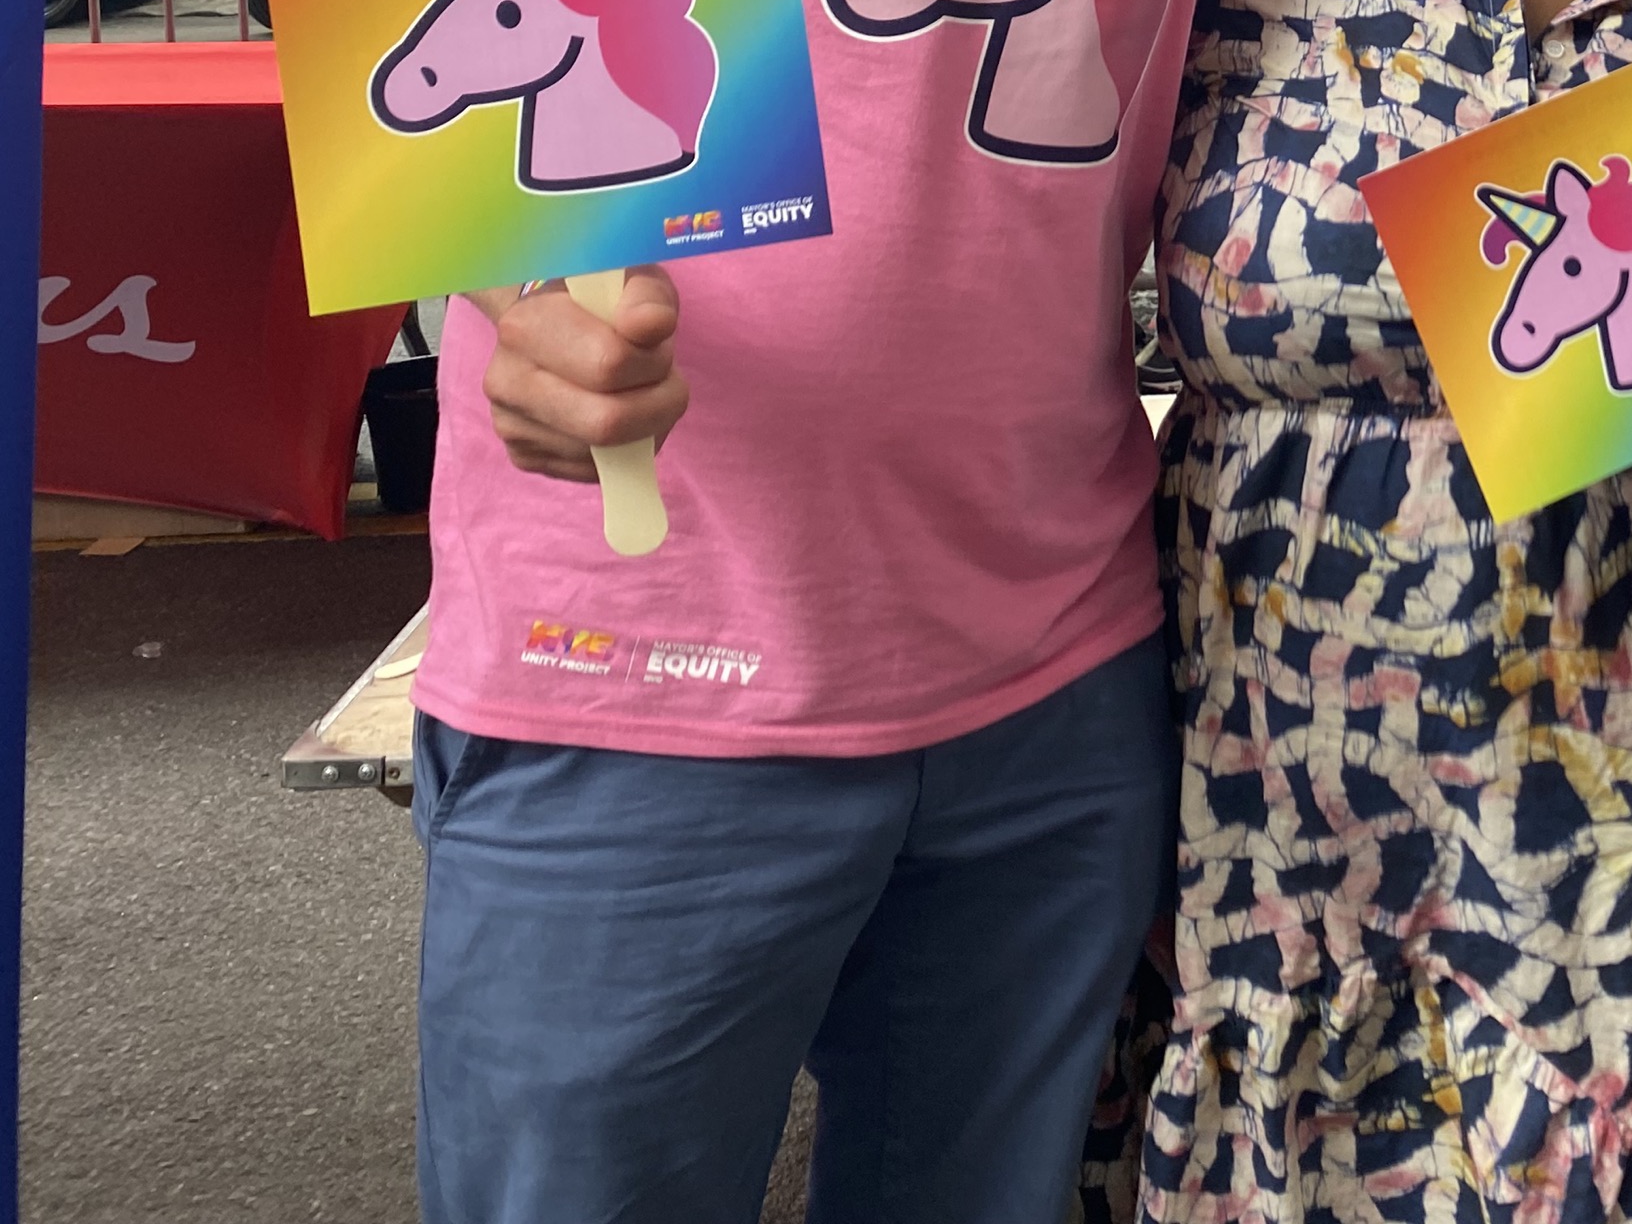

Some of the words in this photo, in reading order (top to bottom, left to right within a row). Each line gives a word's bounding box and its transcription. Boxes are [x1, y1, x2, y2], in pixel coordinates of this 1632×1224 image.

[742, 202, 814, 229] EQUITY
[691, 230, 725, 242] PROJECT
[521, 650, 558, 668] UNITY
[559, 658, 611, 676] PROJECT
[653, 640, 705, 655] MAYOR'S
[706, 646, 745, 661] OFFICE
[746, 652, 762, 663] OF
[646, 650, 760, 686] EQUITY
